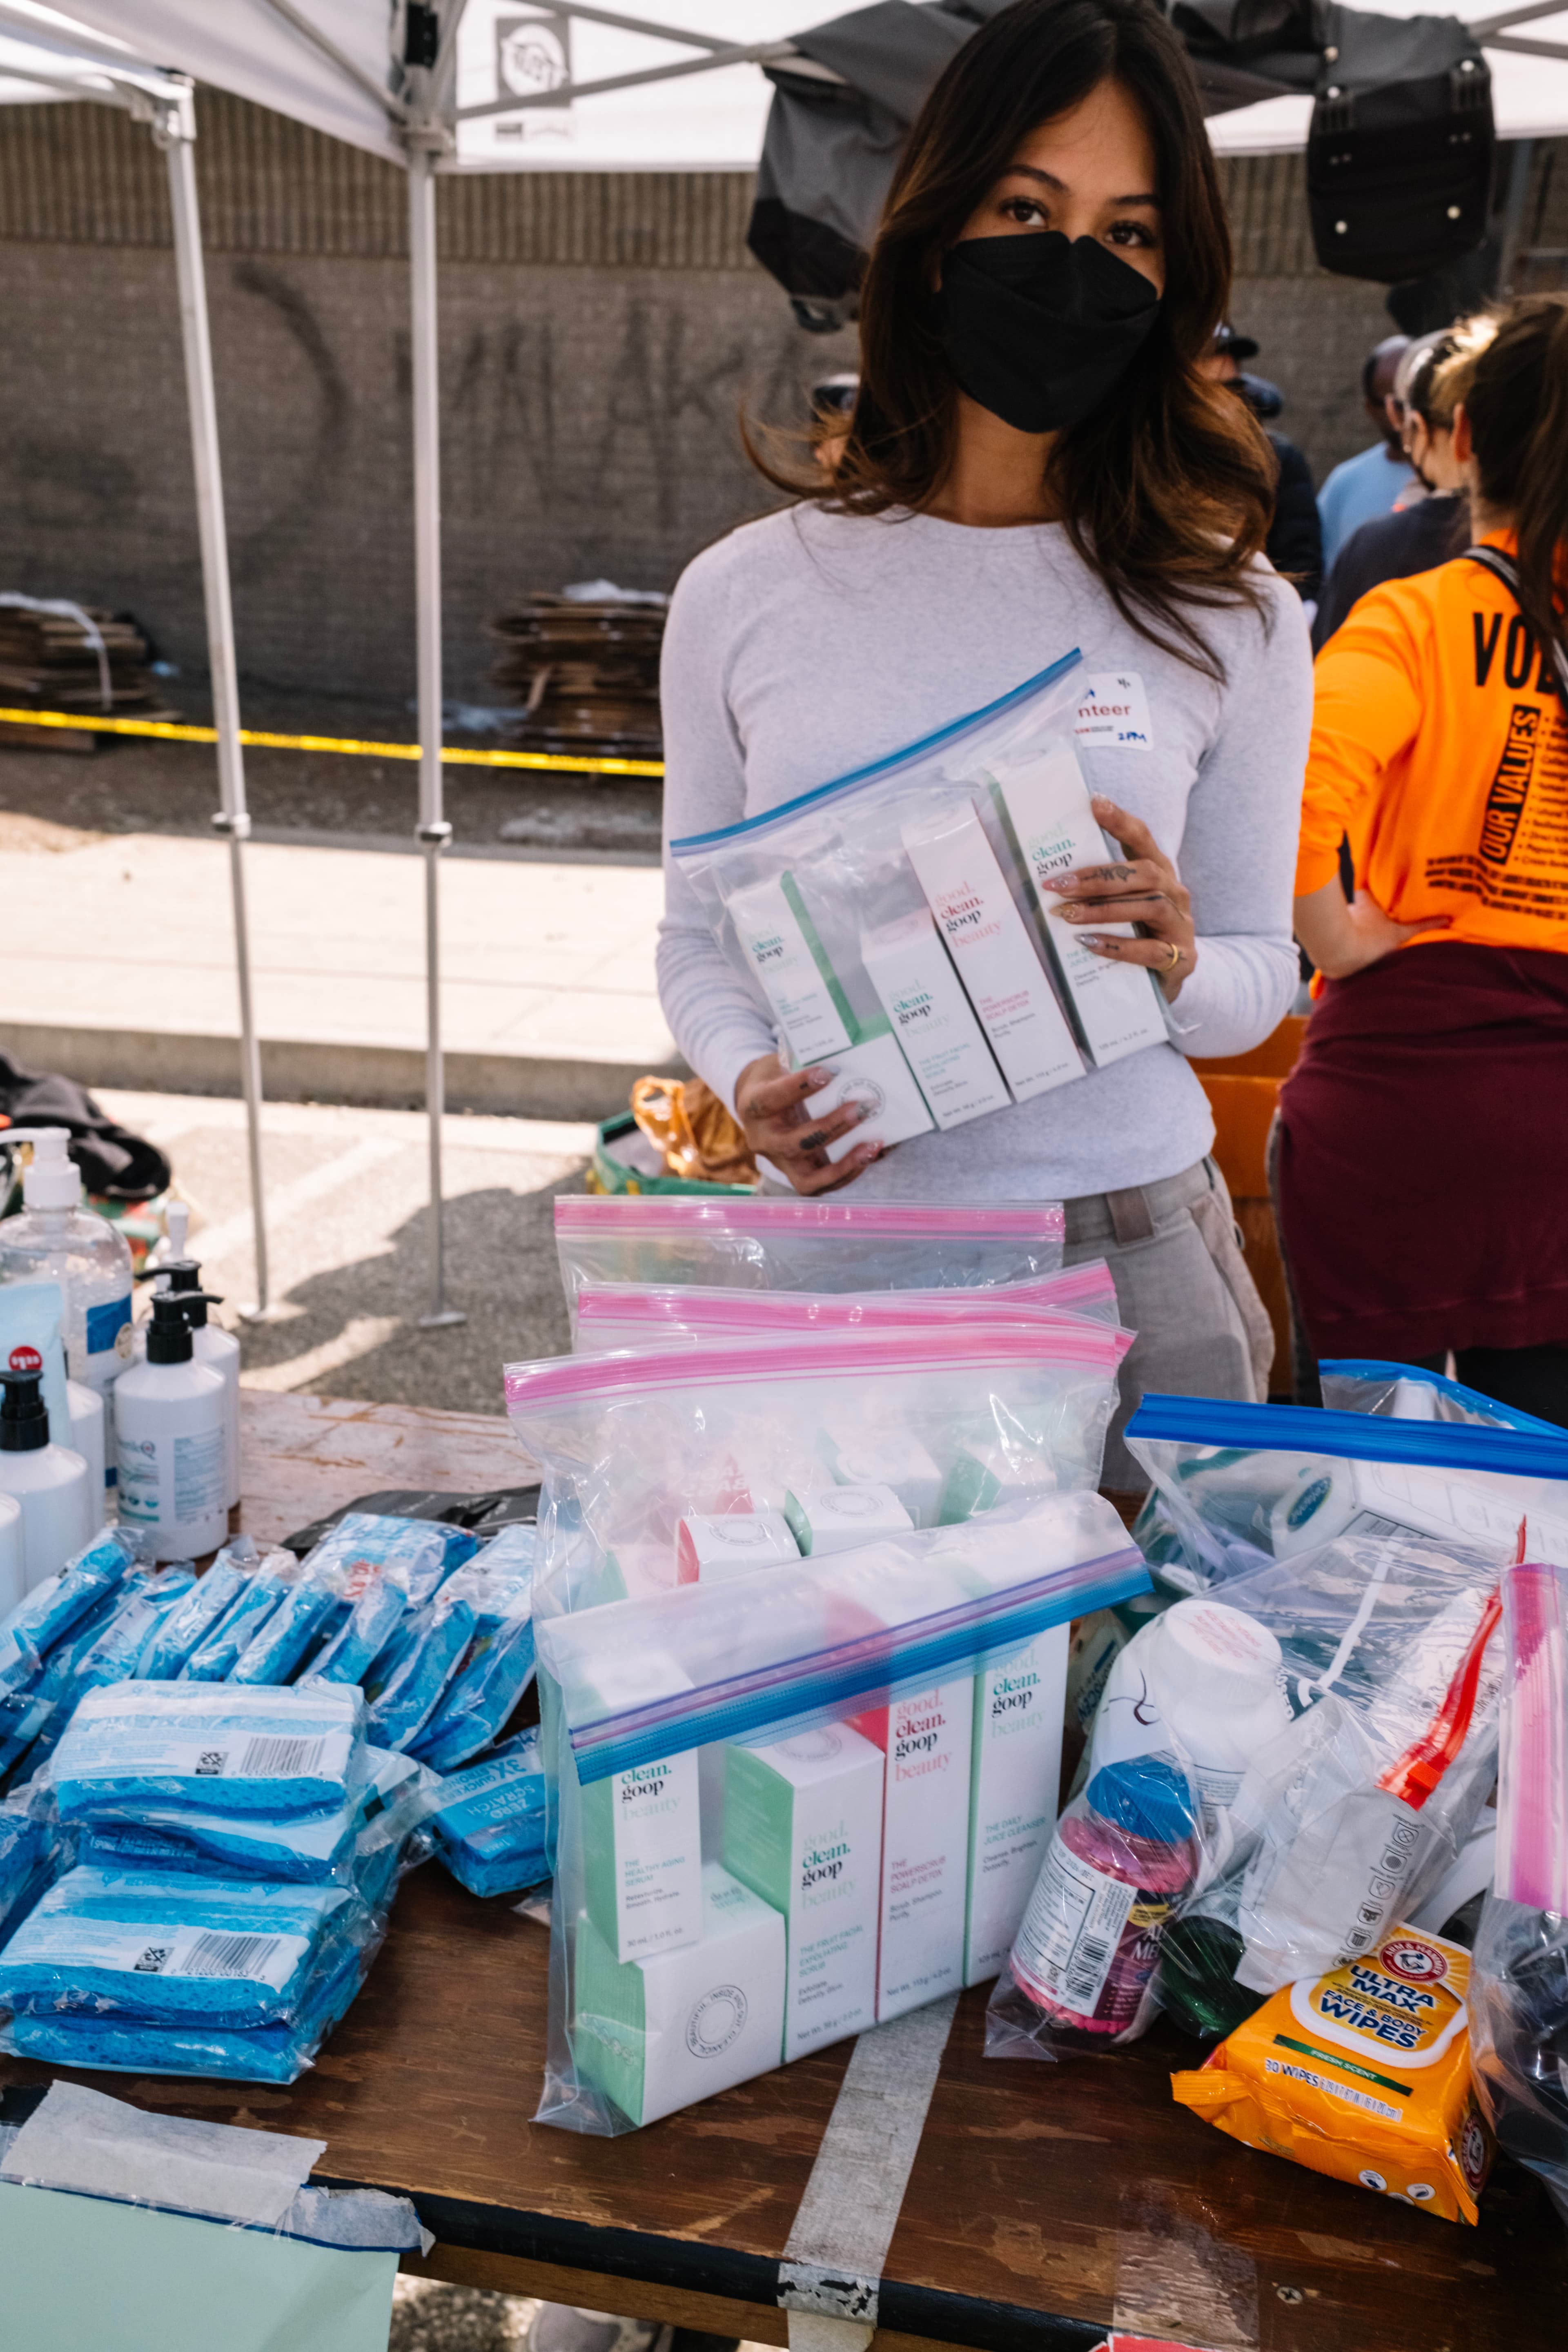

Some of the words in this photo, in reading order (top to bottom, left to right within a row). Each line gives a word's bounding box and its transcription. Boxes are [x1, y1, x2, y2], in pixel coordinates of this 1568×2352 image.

[1078, 705, 1131, 718] nteer
[1492, 709, 1539, 805] VALUES
[1480, 806, 1518, 860] OUR
[1032, 837, 1076, 861] clean.
[1036, 852, 1072, 877] goop
[941, 896, 984, 920] clean.
[946, 909, 981, 934] goop
[953, 920, 1002, 948] beauty
[756, 946, 783, 963] goop
[893, 993, 933, 1013] clean.
[898, 1004, 931, 1026] goop
[993, 1671, 1041, 1696] clean.
[992, 1689, 1032, 1718] goop
[896, 1713, 946, 1739] clean.
[991, 1709, 1045, 1739] beauty
[895, 1732, 938, 1761] goop
[621, 1763, 673, 1784] clean.
[895, 1750, 951, 1783] beauty
[467, 1785, 535, 1815] SCRATCH
[622, 1779, 664, 1803] goop
[491, 1800, 530, 1820] ZERO
[623, 1796, 681, 1821] beauty
[624, 1859, 640, 1868] THE
[625, 1864, 660, 1878] HEALTHY
[662, 1856, 686, 1870] AGING
[802, 1842, 851, 1869] clean.
[891, 1859, 908, 1870] THE
[891, 1855, 947, 1882] POWERSCRUB
[625, 1874, 654, 1887] SERUM
[801, 1860, 842, 1891] goop
[890, 1877, 917, 1893] SCALP
[918, 1869, 942, 1886] DETOX
[802, 1878, 856, 1910] beauty
[627, 1939, 639, 1948] 30
[800, 1944, 815, 1955] THE
[816, 1936, 837, 1951] FRUIT
[839, 1924, 864, 1941] FACIAL
[1385, 1943, 1404, 1957] ARM
[1415, 1942, 1444, 1975] HAMMER
[1350, 1964, 1434, 2008] ULTRA
[1352, 1979, 1421, 2013] MAX
[1320, 1997, 1419, 2048] WIPES
[1324, 1989, 1365, 2012] FACE
[1366, 2009, 1378, 2017] &
[1381, 2014, 1428, 2036] BODY
[1265, 2058, 1280, 2073] 30
[1282, 2064, 1319, 2087] WIPES
[1310, 2049, 1343, 2066] FRESH
[1343, 2062, 1378, 2080] SCENT
